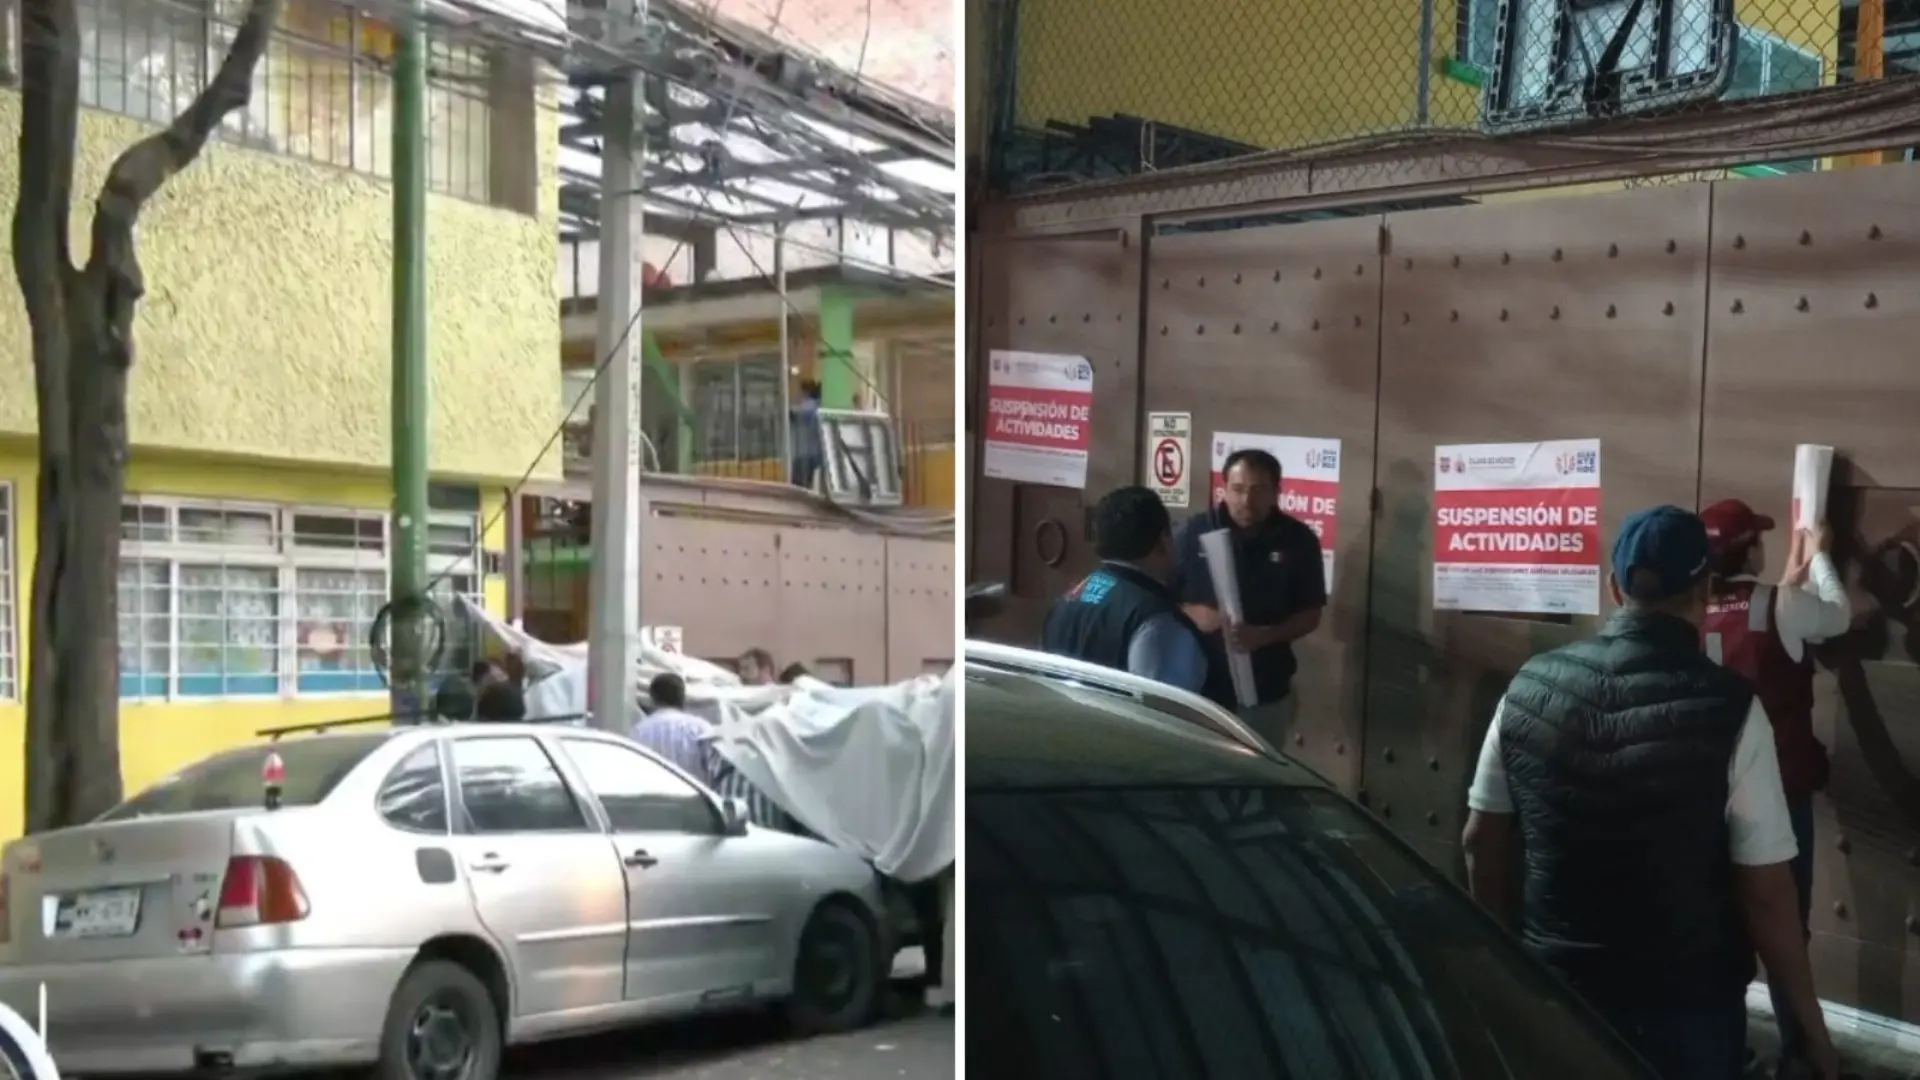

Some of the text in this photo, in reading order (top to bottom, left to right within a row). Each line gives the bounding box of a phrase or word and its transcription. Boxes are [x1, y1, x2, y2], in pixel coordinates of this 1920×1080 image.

[989, 398, 1090, 421] SUSPENSIÓN DE
[996, 418, 1080, 441] ACTIVIDADES
[1312, 496, 1337, 516] DE
[1436, 501, 1598, 527] SUSPENSIÓN DE
[1449, 532, 1584, 552] ACTIVIDADES
